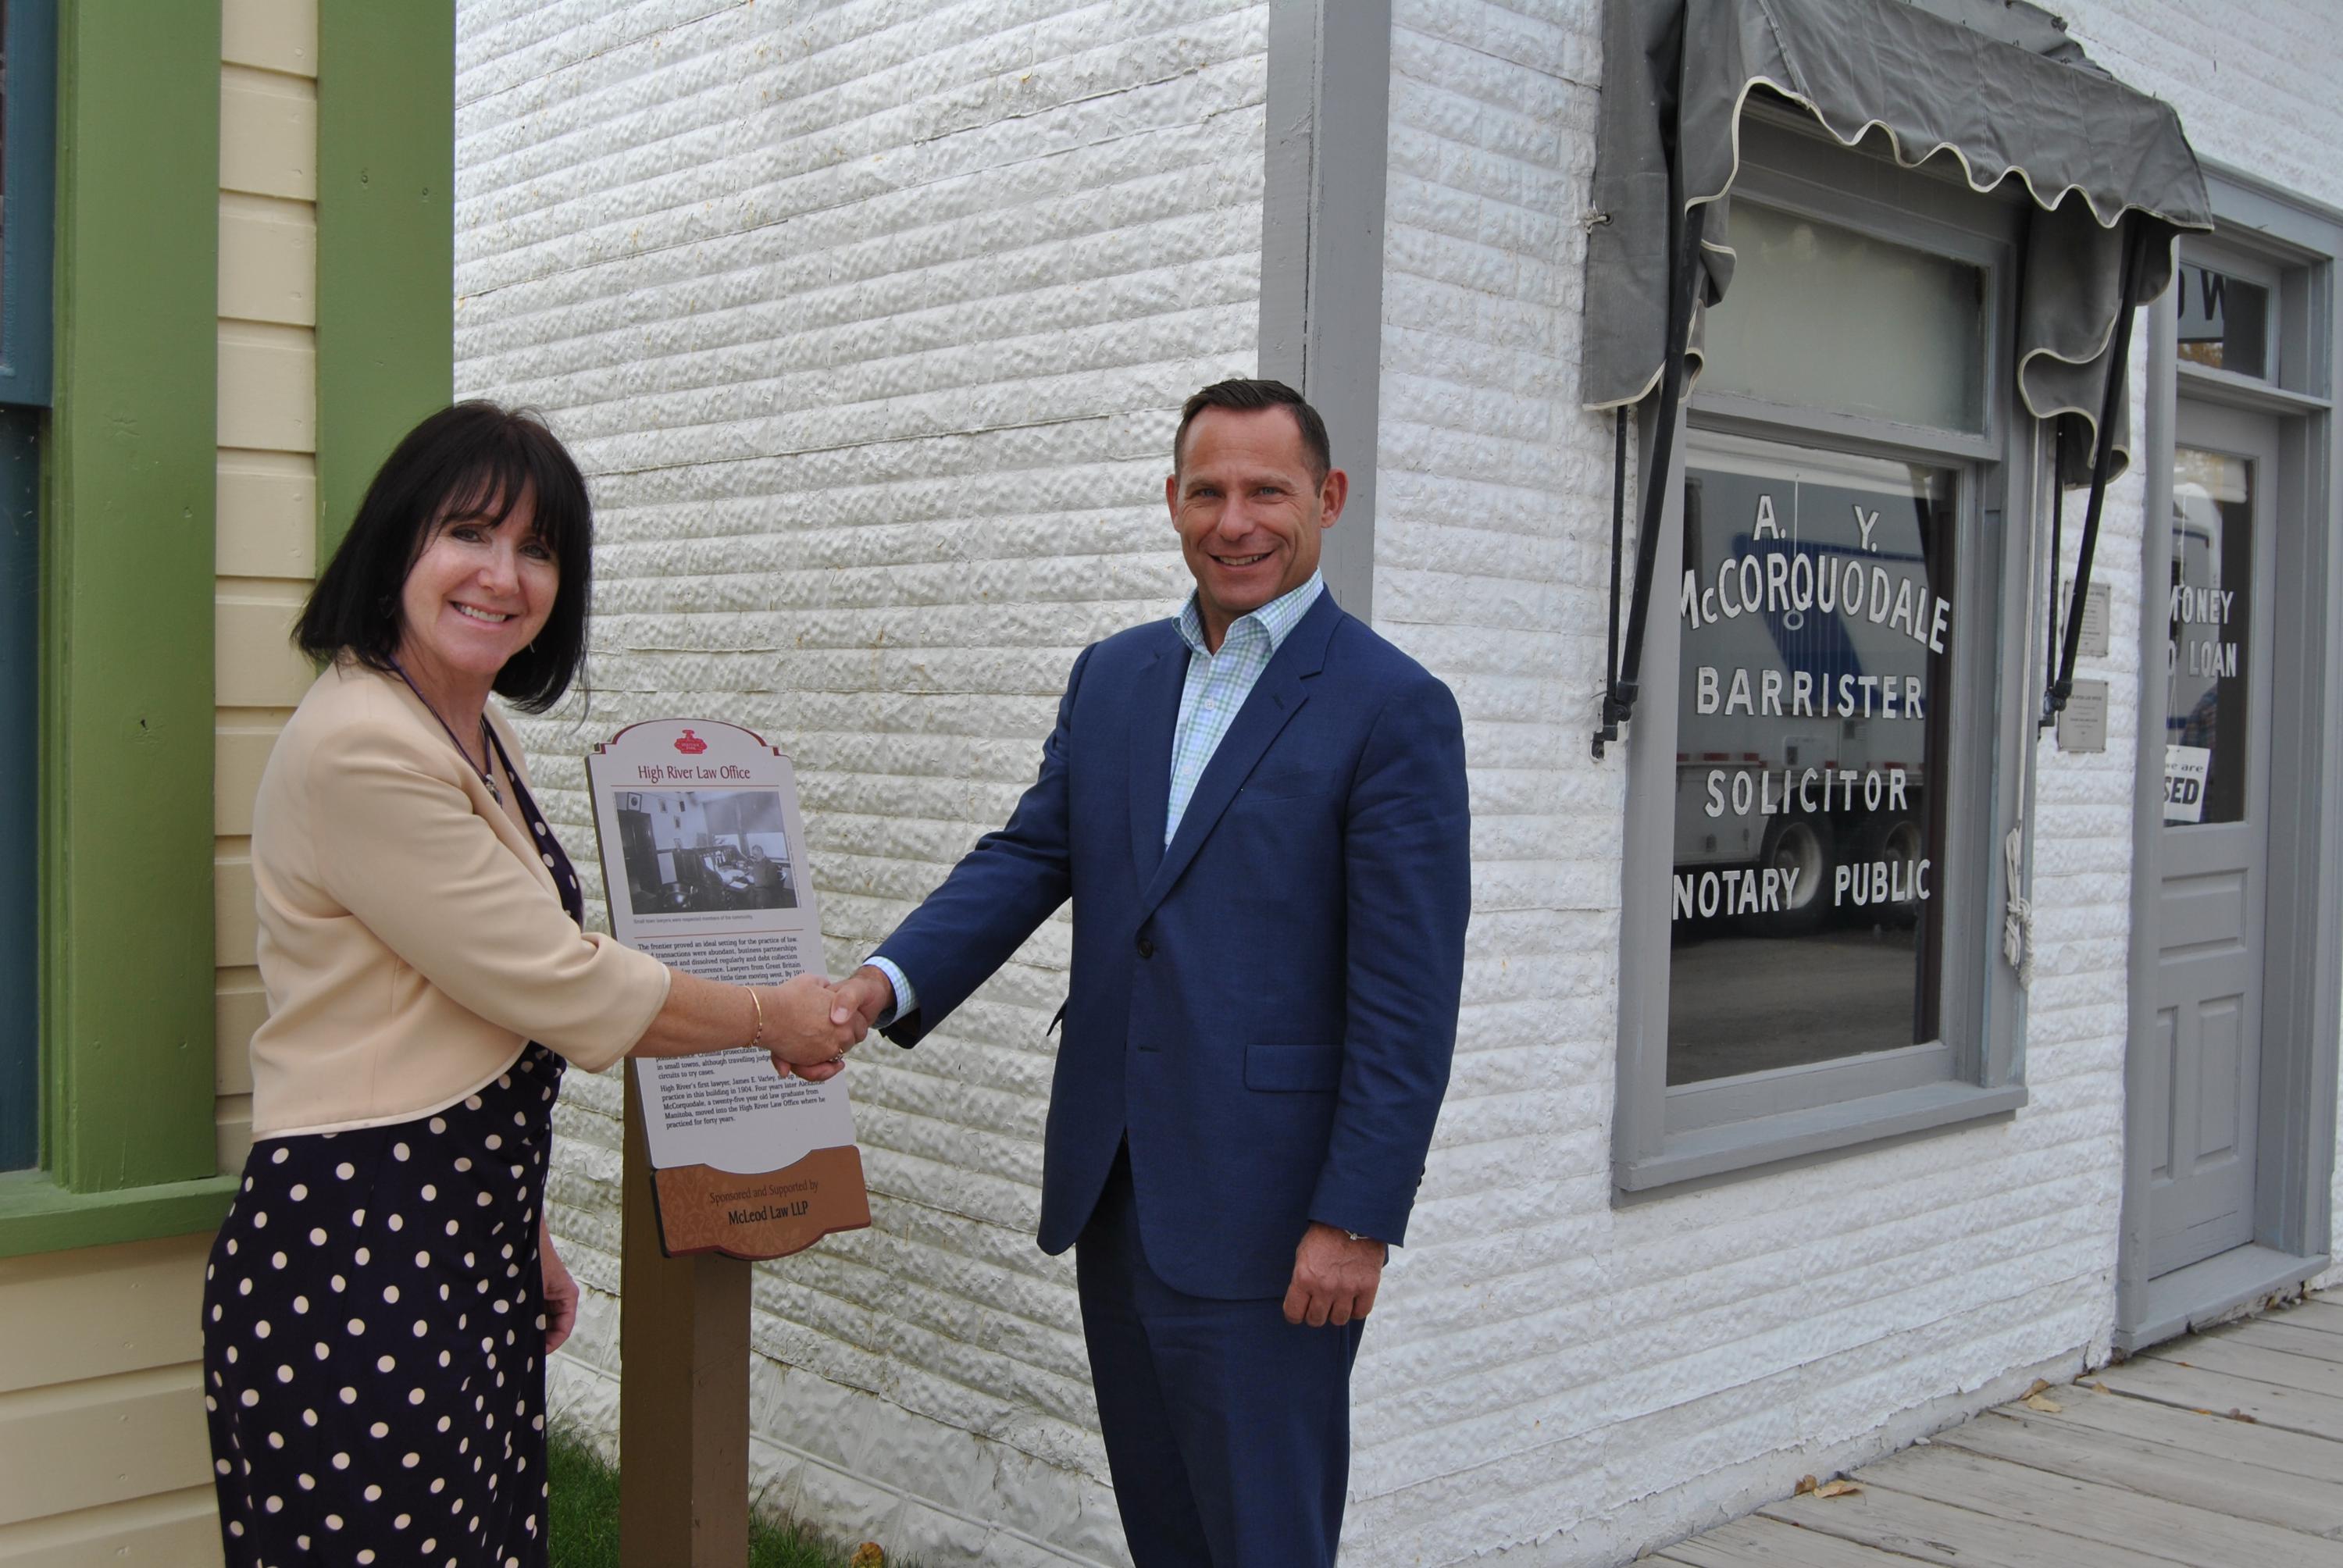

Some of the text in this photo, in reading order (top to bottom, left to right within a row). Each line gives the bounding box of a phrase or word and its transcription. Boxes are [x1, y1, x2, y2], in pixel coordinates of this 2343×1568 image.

[1753, 494, 1881, 552] A. Y.
[2188, 640, 2237, 678] LOAN
[1696, 665, 1924, 720] BARRISTER
[638, 764, 751, 783] High River Law Office
[2181, 764, 2203, 772] are
[1704, 768, 1907, 818] SOLICITOR
[2163, 776, 2199, 805] SED
[1672, 858, 1931, 921] NOTARY PUBLIC
[674, 941, 694, 950] proved
[763, 945, 797, 953] partnerships
[691, 957, 718, 966] dissolved
[719, 957, 744, 965] regularly
[785, 970, 792, 978] By
[702, 1058, 727, 1067] although
[756, 1054, 771, 1063] judg
[660, 1085, 675, 1093] High
[676, 1082, 697, 1091] River's
[662, 1093, 685, 1103] practice
[706, 1089, 729, 1097] building
[695, 1108, 715, 1117] moved
[739, 1103, 753, 1113] High
[754, 1102, 769, 1110] River
[783, 1099, 800, 1107] Office
[801, 1096, 817, 1105] where
[712, 1095, 744, 1106] twenty-five
[780, 1090, 805, 1099] graduate
[666, 1115, 736, 1130] practiced for forty years.
[709, 1178, 818, 1206] Sponsored and Supported by
[728, 1200, 809, 1225] McLeod Law LLP
